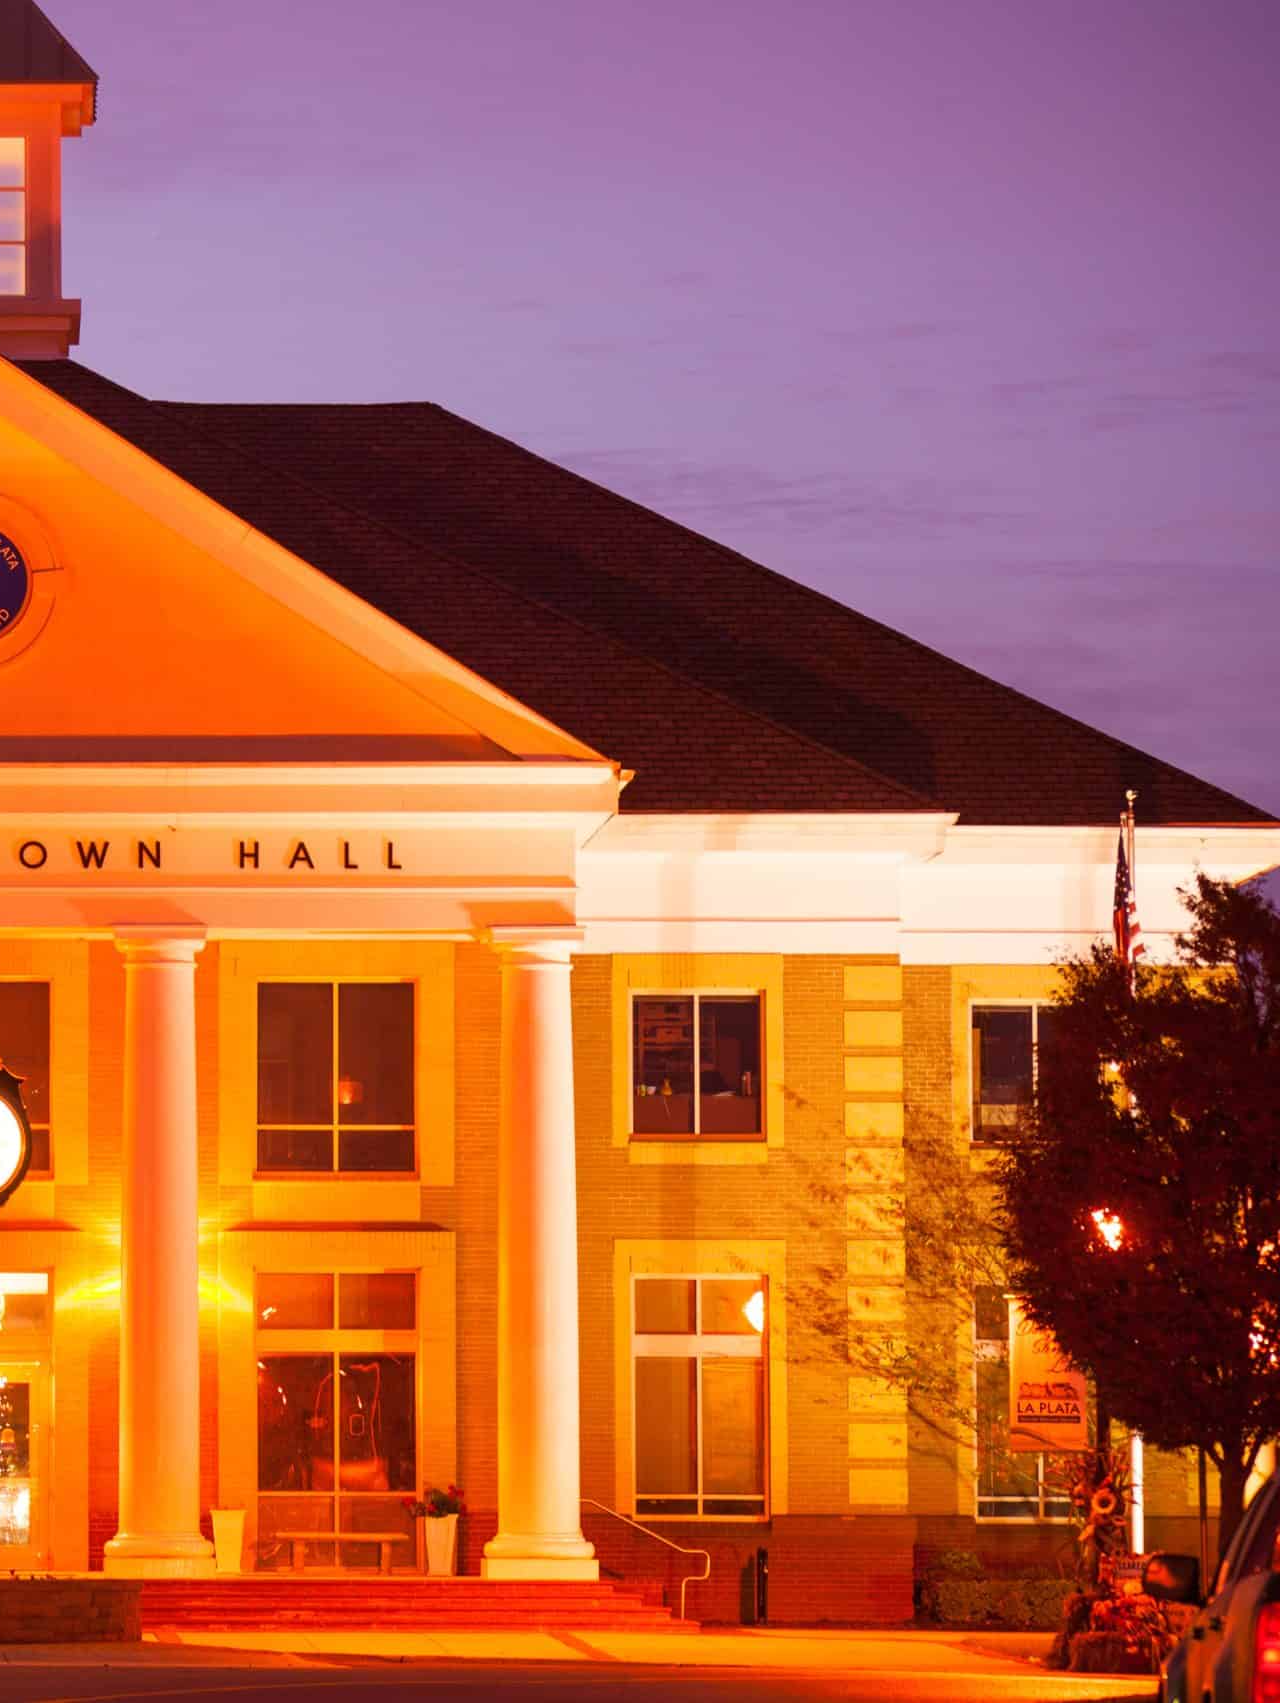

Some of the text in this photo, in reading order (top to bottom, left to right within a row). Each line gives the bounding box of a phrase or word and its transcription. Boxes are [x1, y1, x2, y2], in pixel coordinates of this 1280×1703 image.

[239, 841, 402, 869] HALL
[1017, 1402, 1081, 1414] LA PLATA
